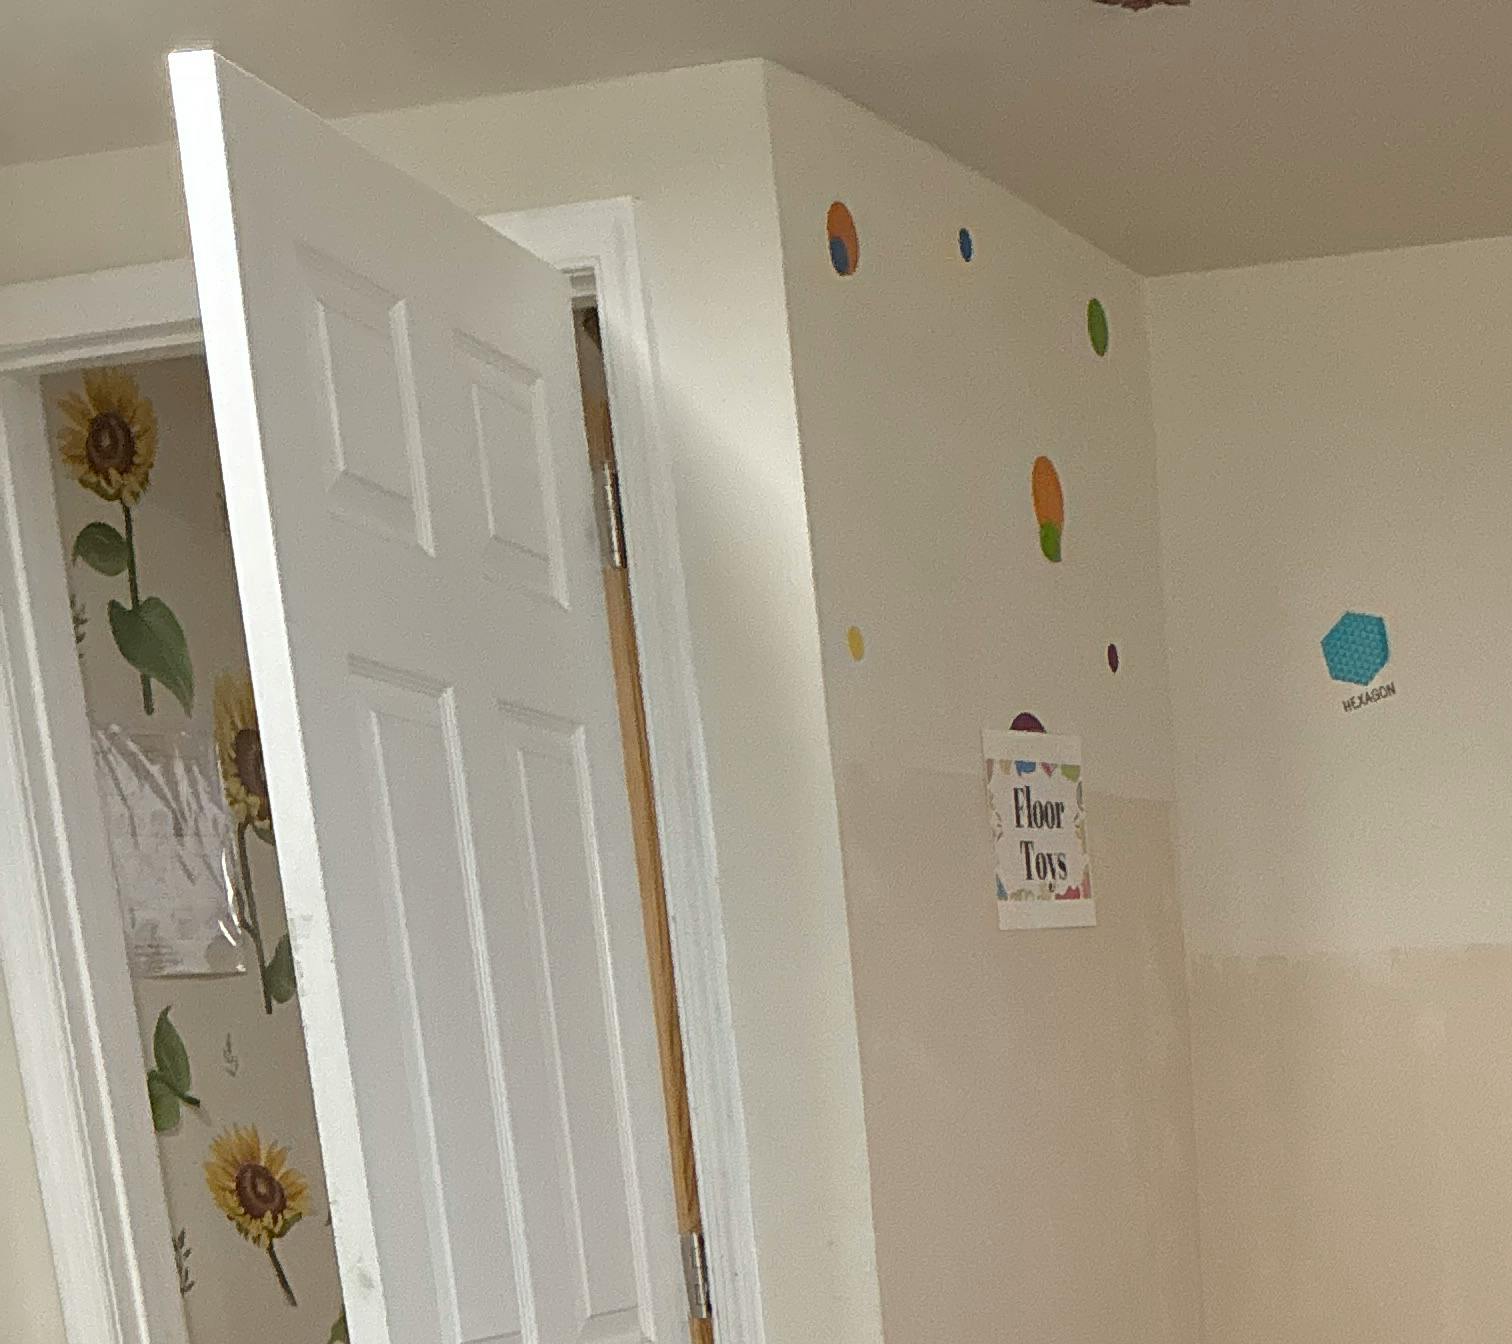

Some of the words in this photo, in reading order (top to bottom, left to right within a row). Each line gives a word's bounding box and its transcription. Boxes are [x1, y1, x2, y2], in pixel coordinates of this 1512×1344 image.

[1342, 682, 1396, 712] HEXAGON
[1013, 785, 1065, 829] Floor
[1020, 840, 1068, 893] Toys
